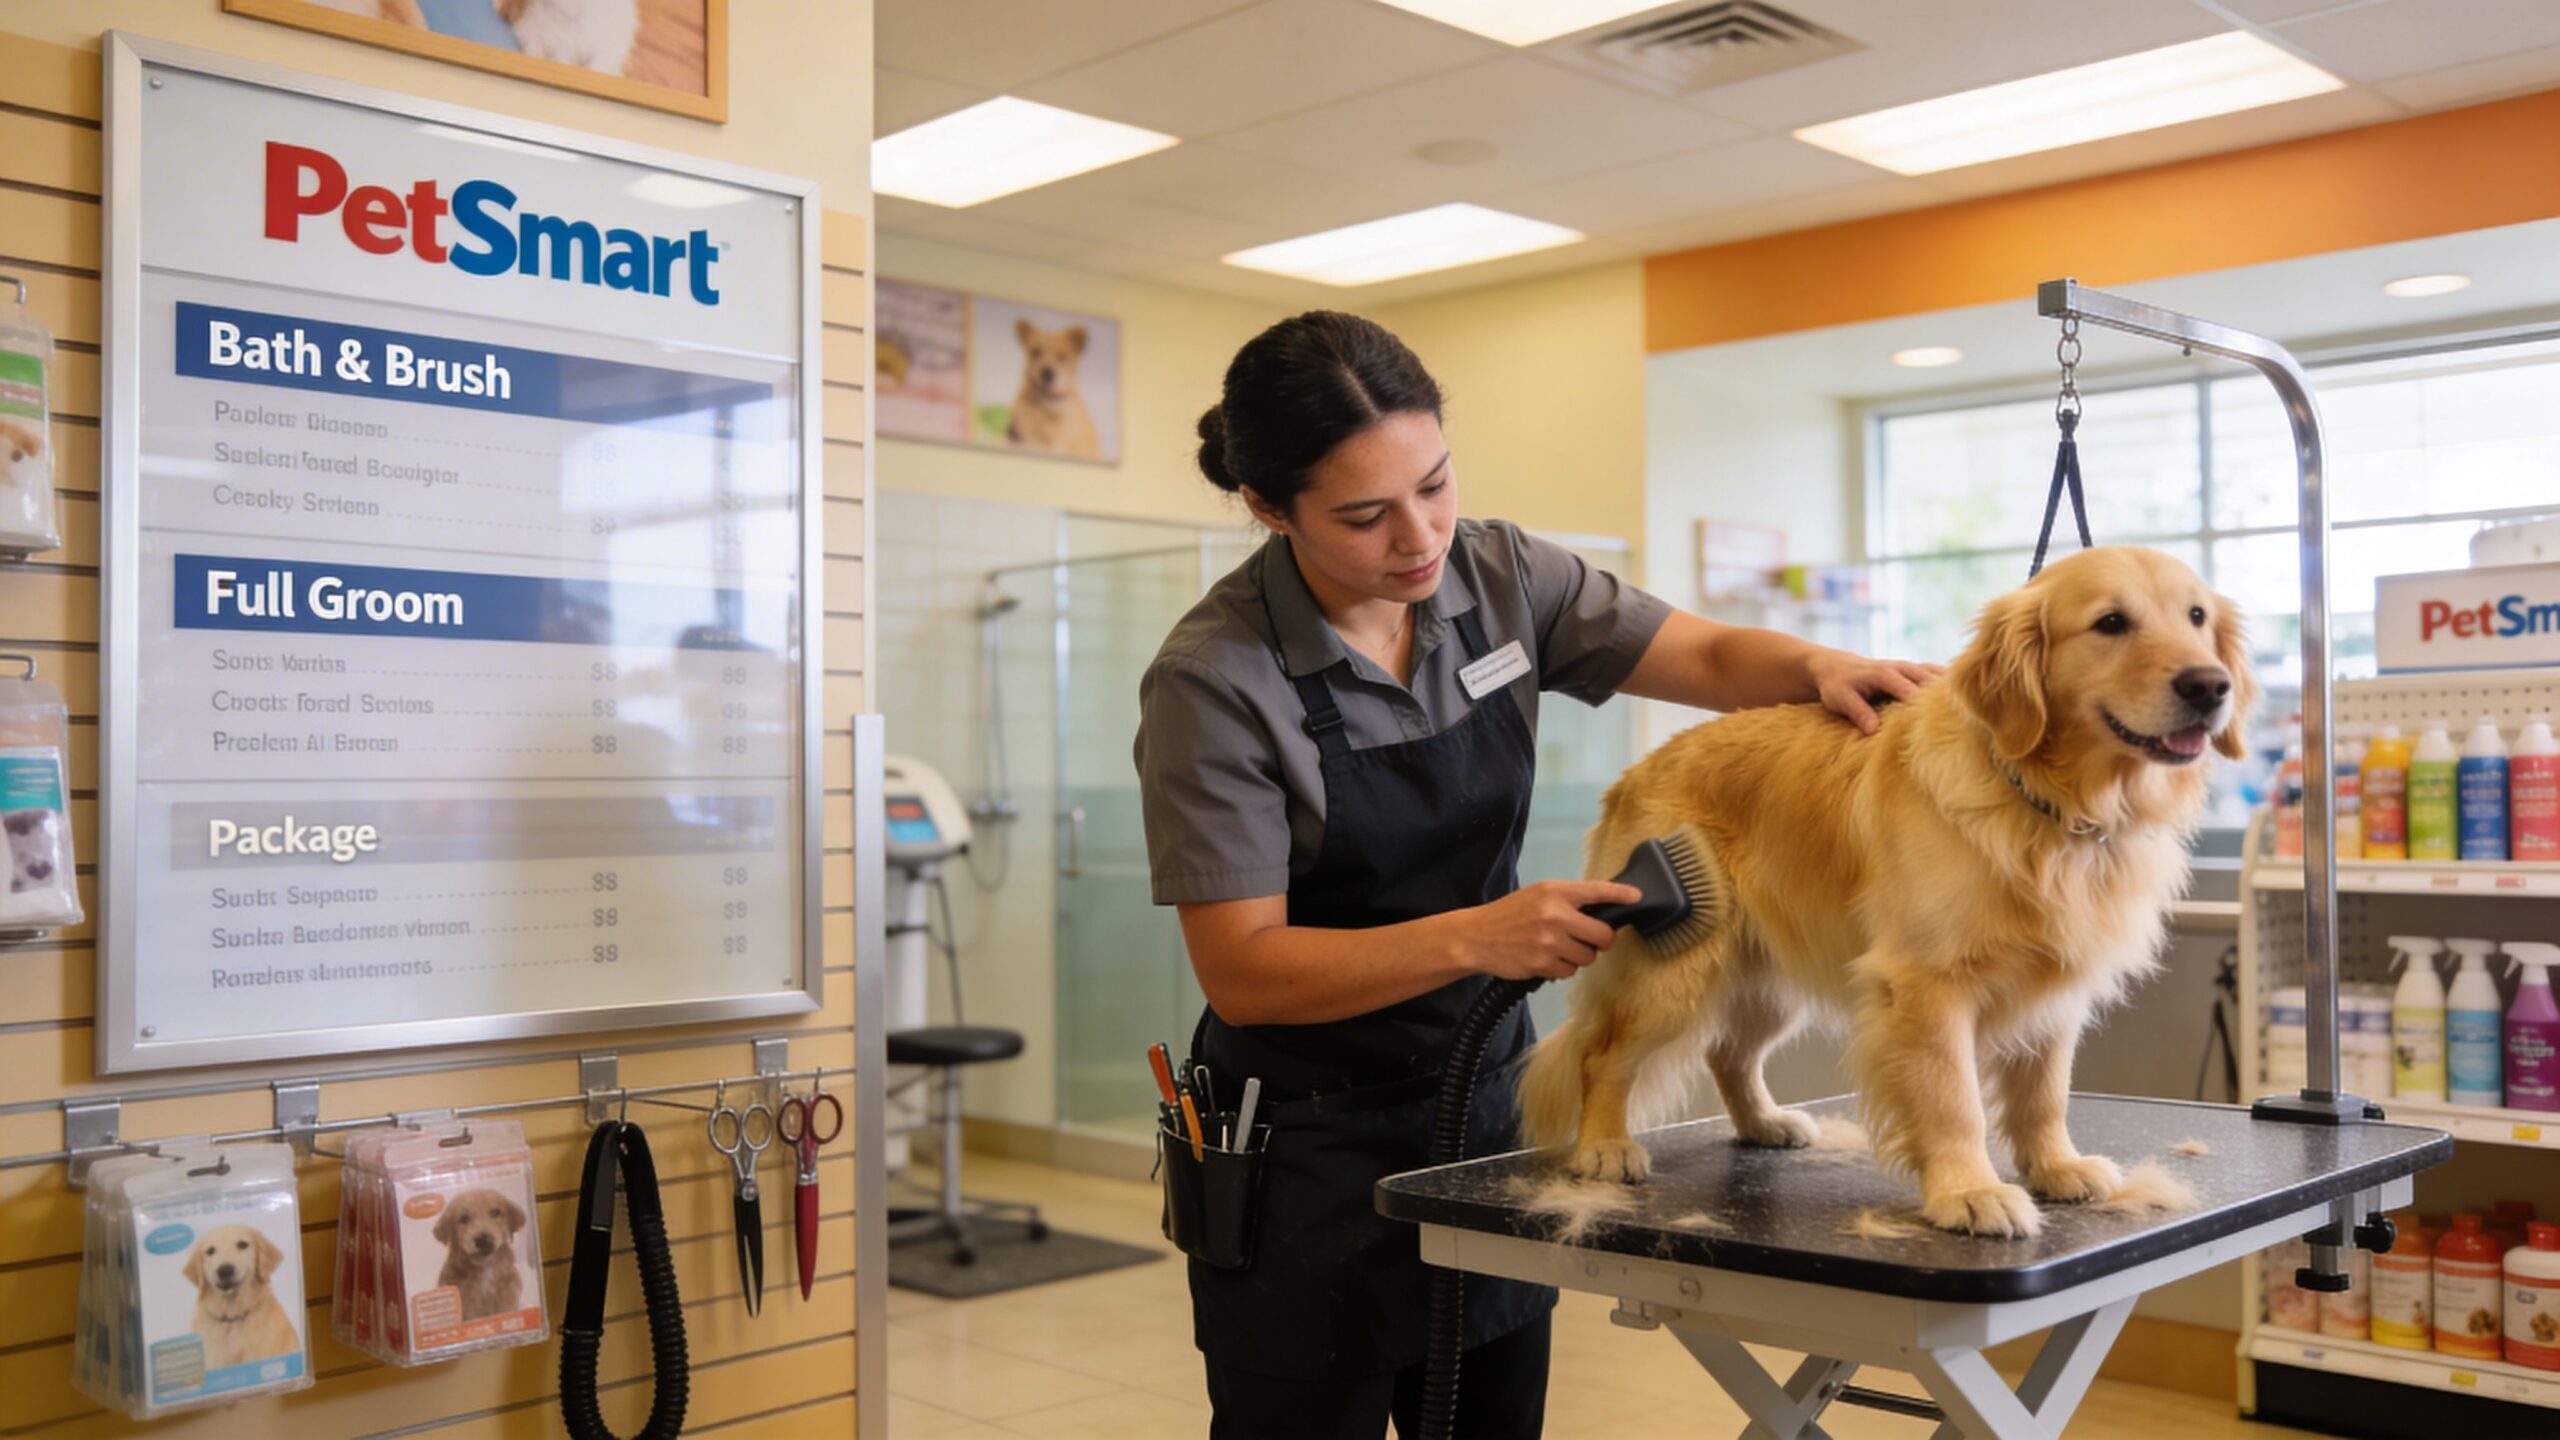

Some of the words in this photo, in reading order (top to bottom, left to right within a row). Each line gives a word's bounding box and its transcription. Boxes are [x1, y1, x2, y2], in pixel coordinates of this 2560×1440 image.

[263, 140, 720, 306] PetSmart
[208, 320, 322, 377] Bath
[334, 339, 371, 383] &
[385, 343, 512, 400] Brush
[207, 570, 294, 618] Full
[307, 576, 464, 626] Groom
[208, 815, 380, 863] Package
